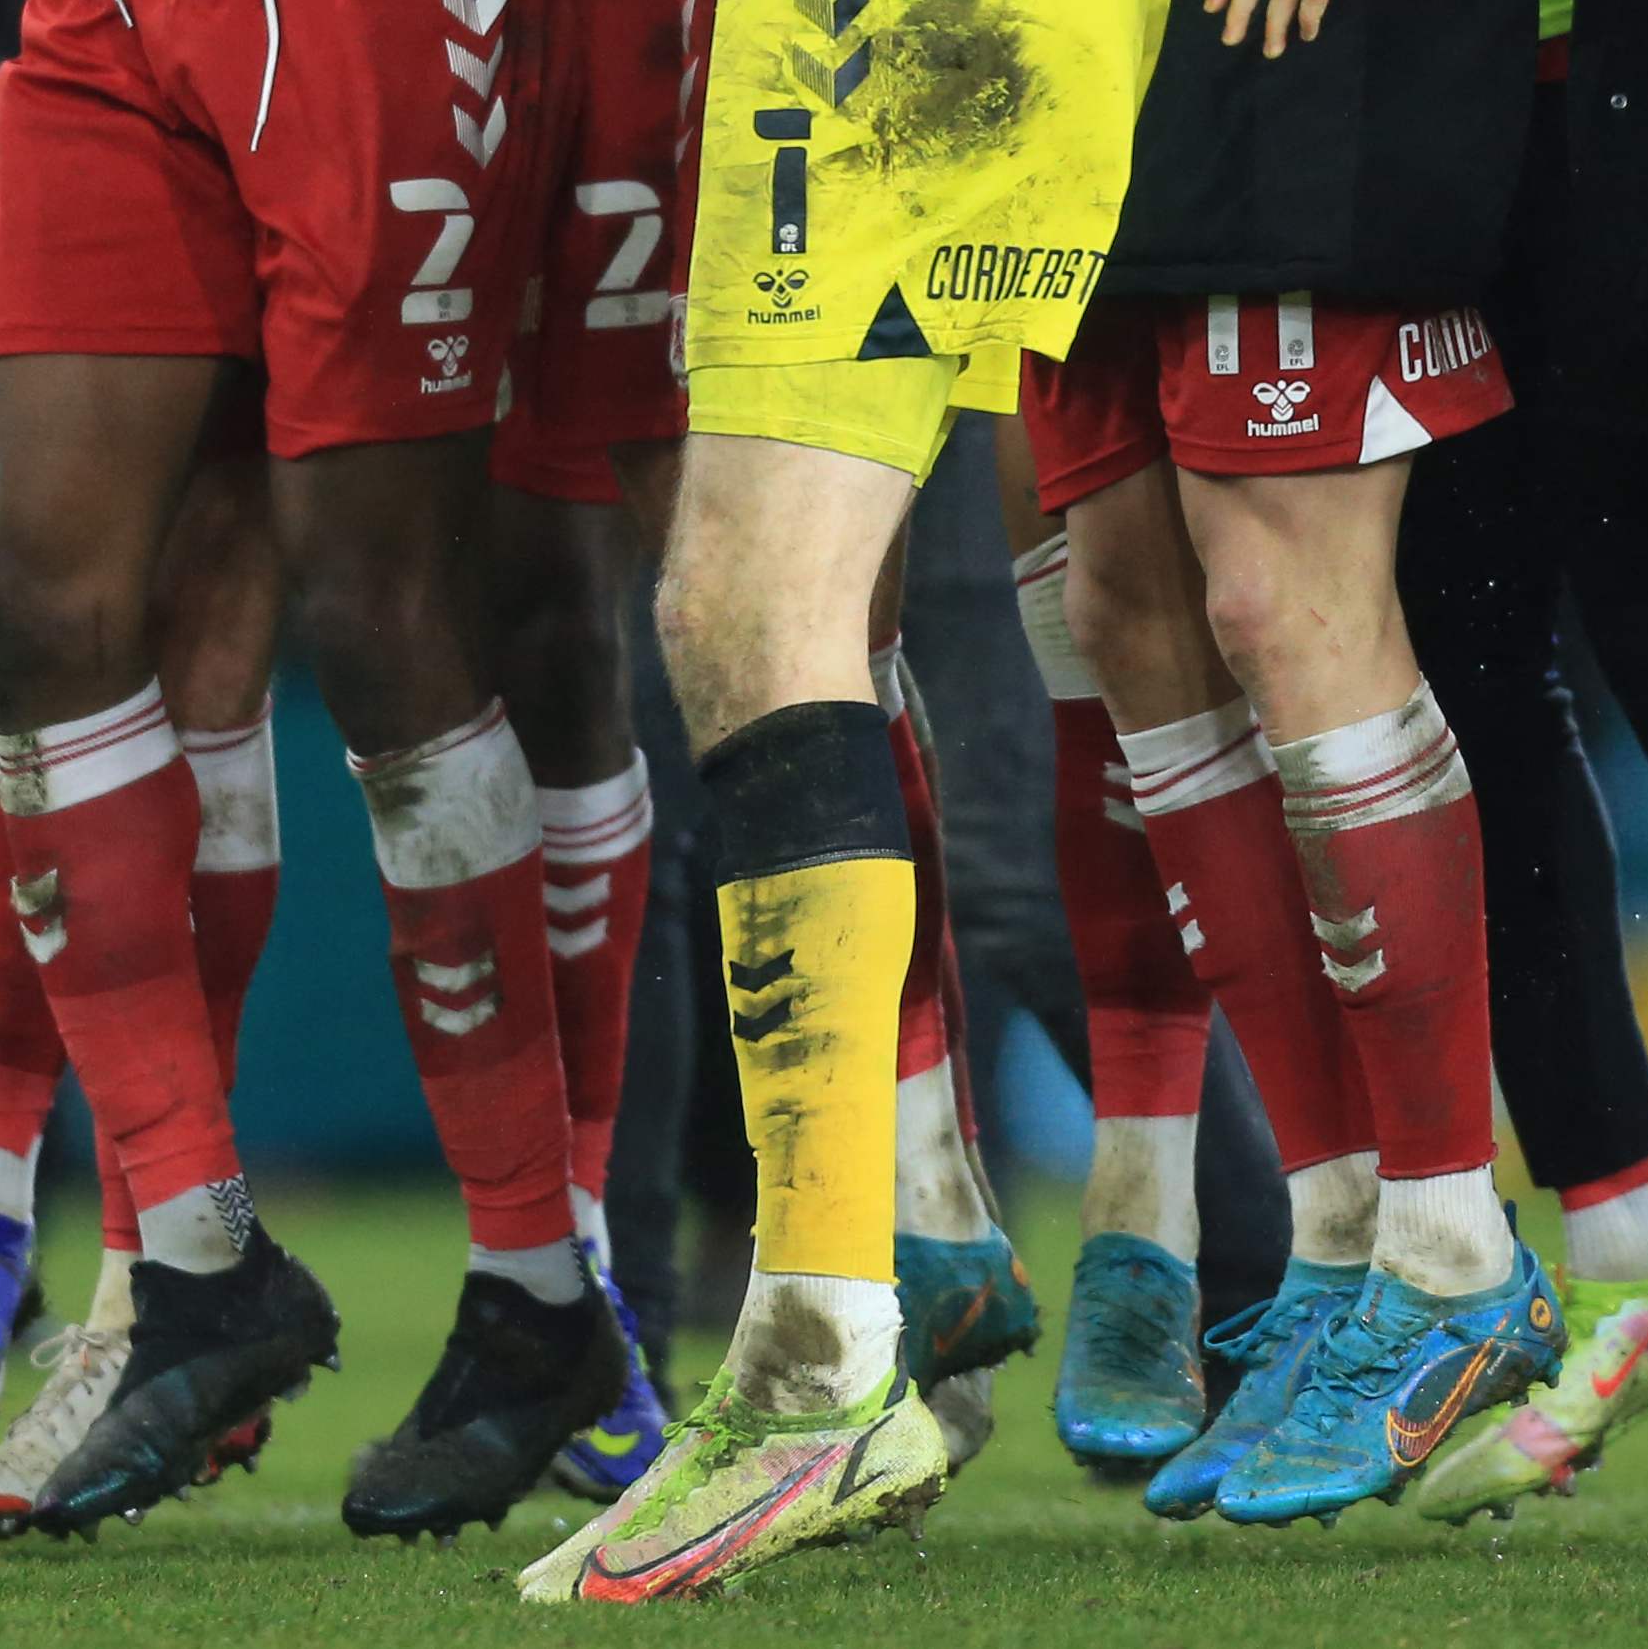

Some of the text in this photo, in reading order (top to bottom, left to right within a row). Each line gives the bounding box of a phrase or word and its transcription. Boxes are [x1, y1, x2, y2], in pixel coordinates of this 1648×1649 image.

[388, 177, 475, 324] 2
[753, 108, 812, 254] 1
[574, 179, 670, 330] 2
[747, 305, 822, 325] hummel
[1247, 413, 1320, 437] hummel
